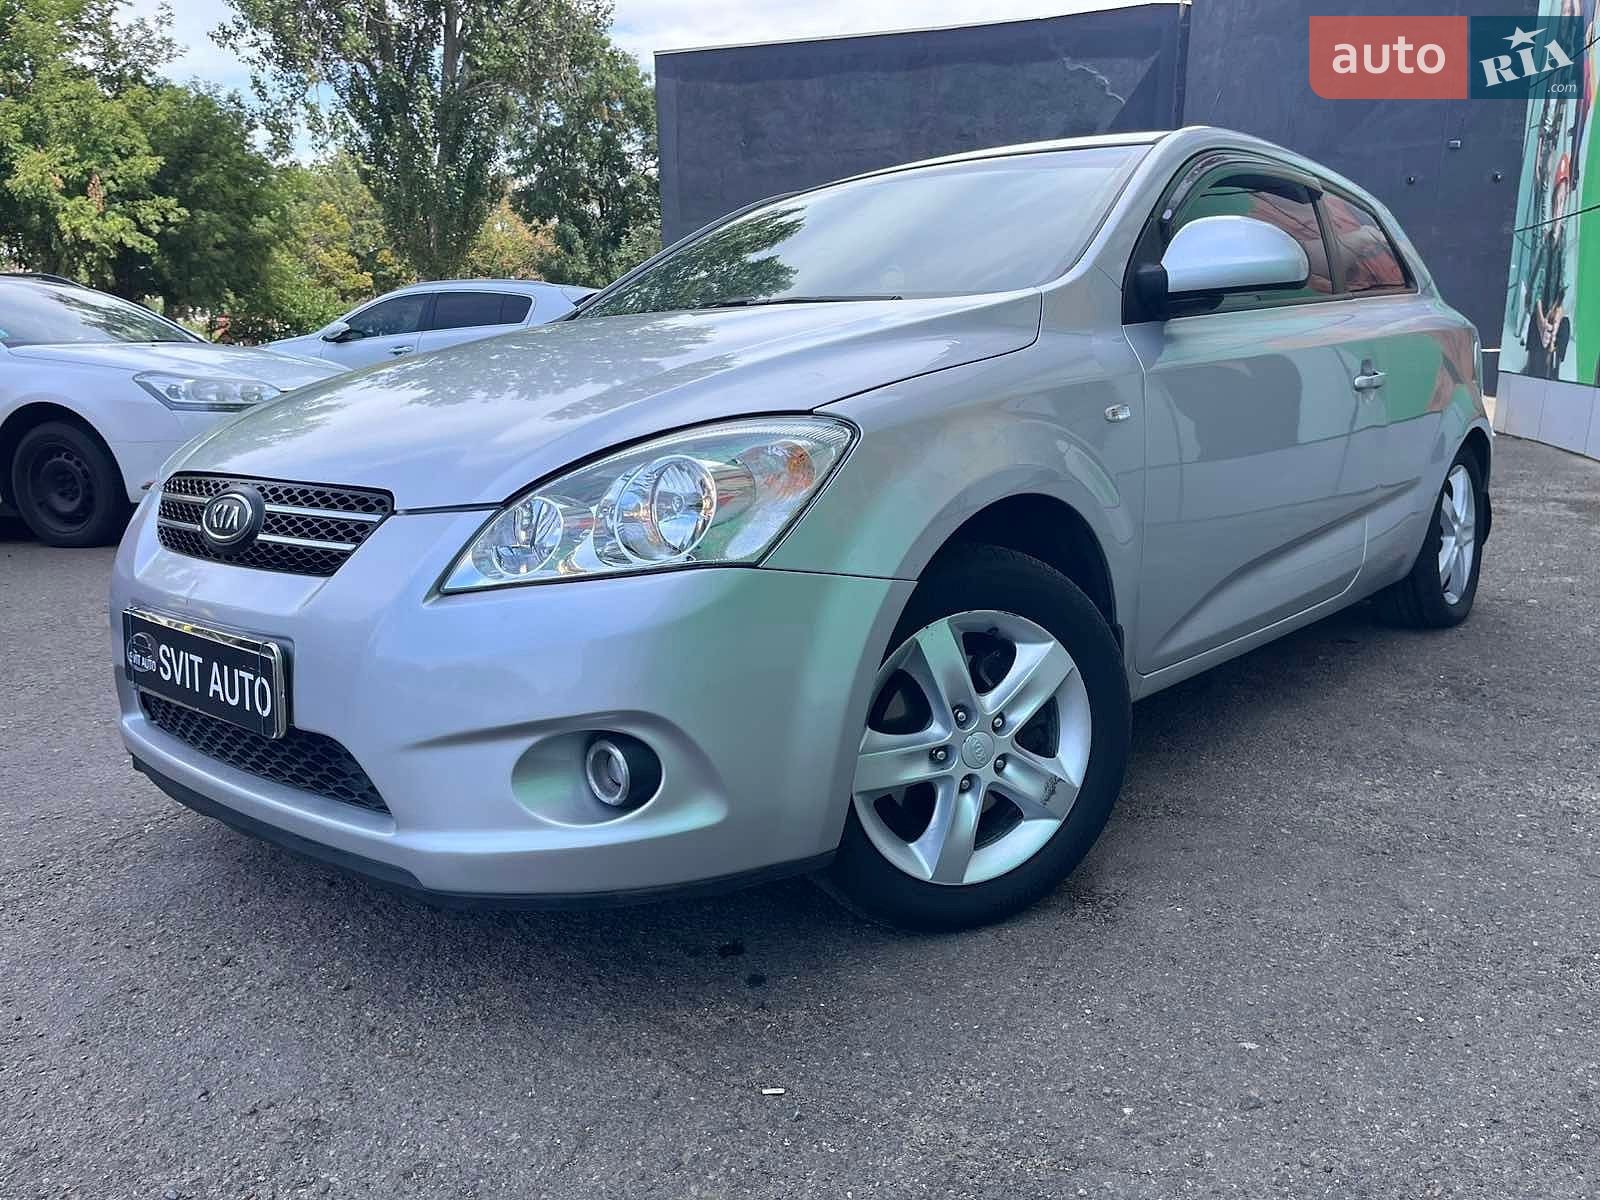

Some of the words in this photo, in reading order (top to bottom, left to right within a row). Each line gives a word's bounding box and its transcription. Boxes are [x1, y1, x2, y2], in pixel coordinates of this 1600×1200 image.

[209, 503, 240, 531] KIA
[159, 644, 203, 692] SVIT
[209, 661, 272, 717] AUTO
